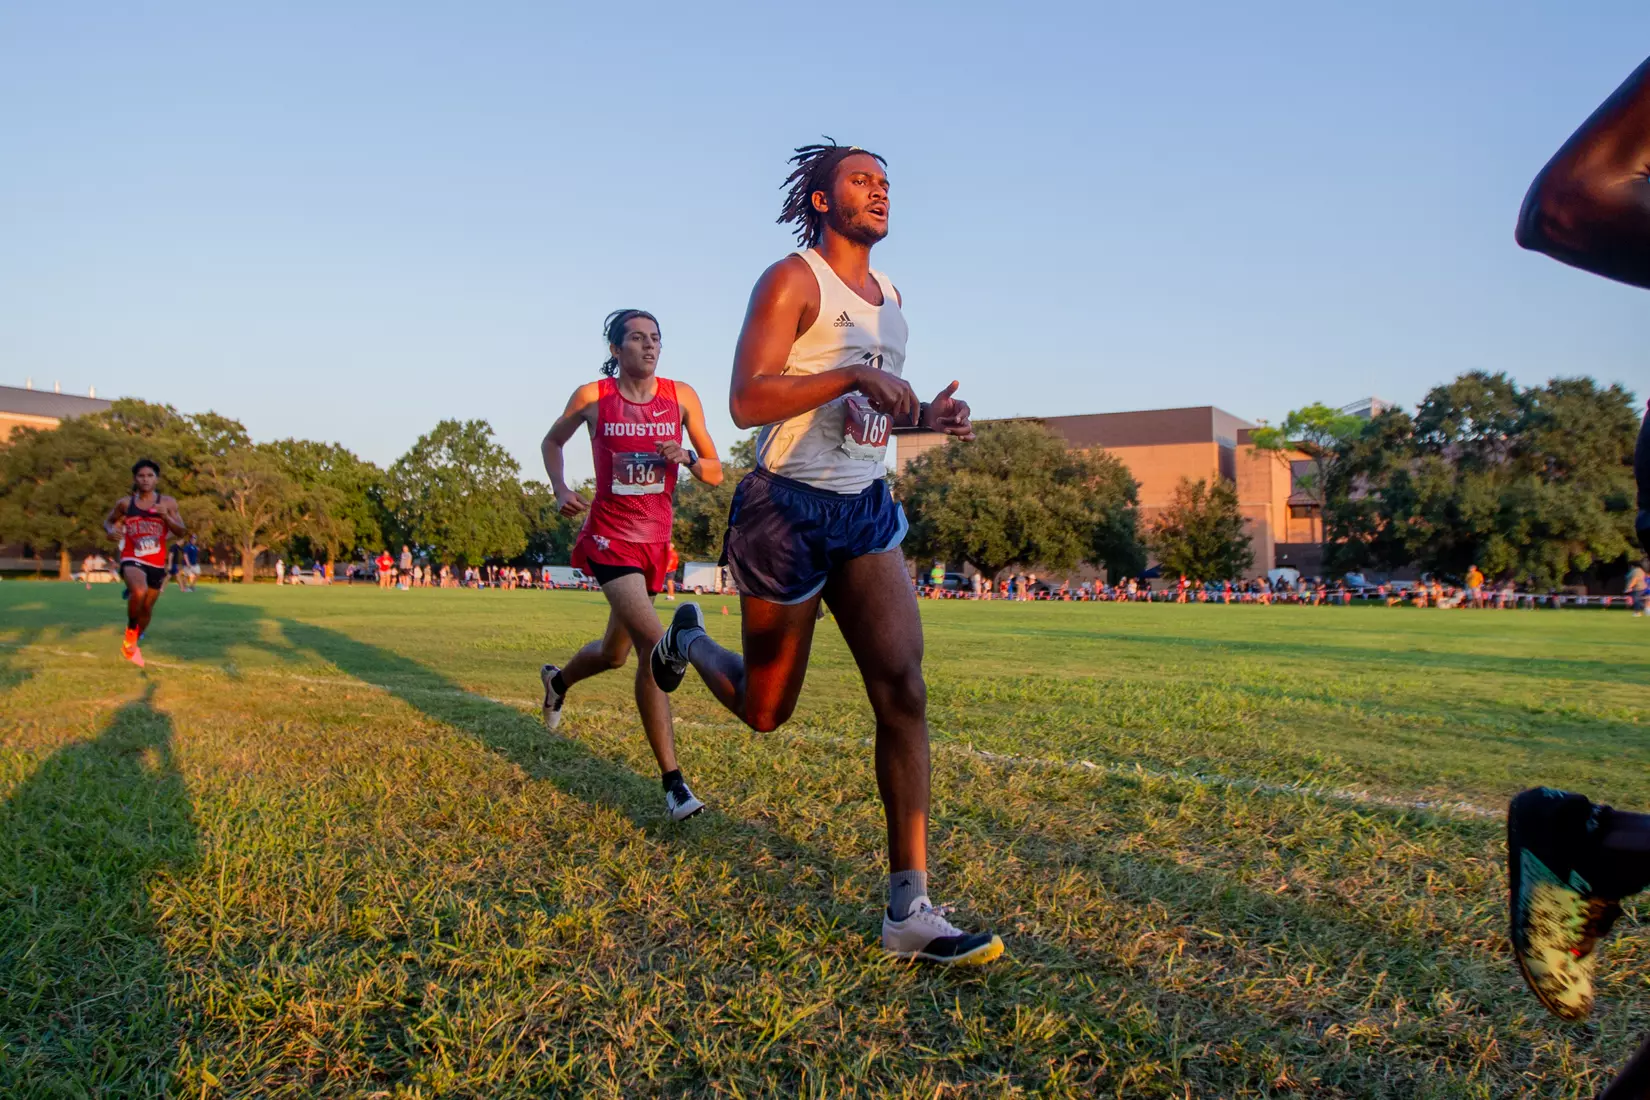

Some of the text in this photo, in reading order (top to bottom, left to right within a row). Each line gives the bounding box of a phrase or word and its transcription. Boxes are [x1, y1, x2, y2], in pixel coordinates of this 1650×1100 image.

[833, 320, 855, 328] adidas
[604, 422, 675, 436] HOUSTON
[862, 413, 888, 444] 169
[626, 463, 656, 483] 136
